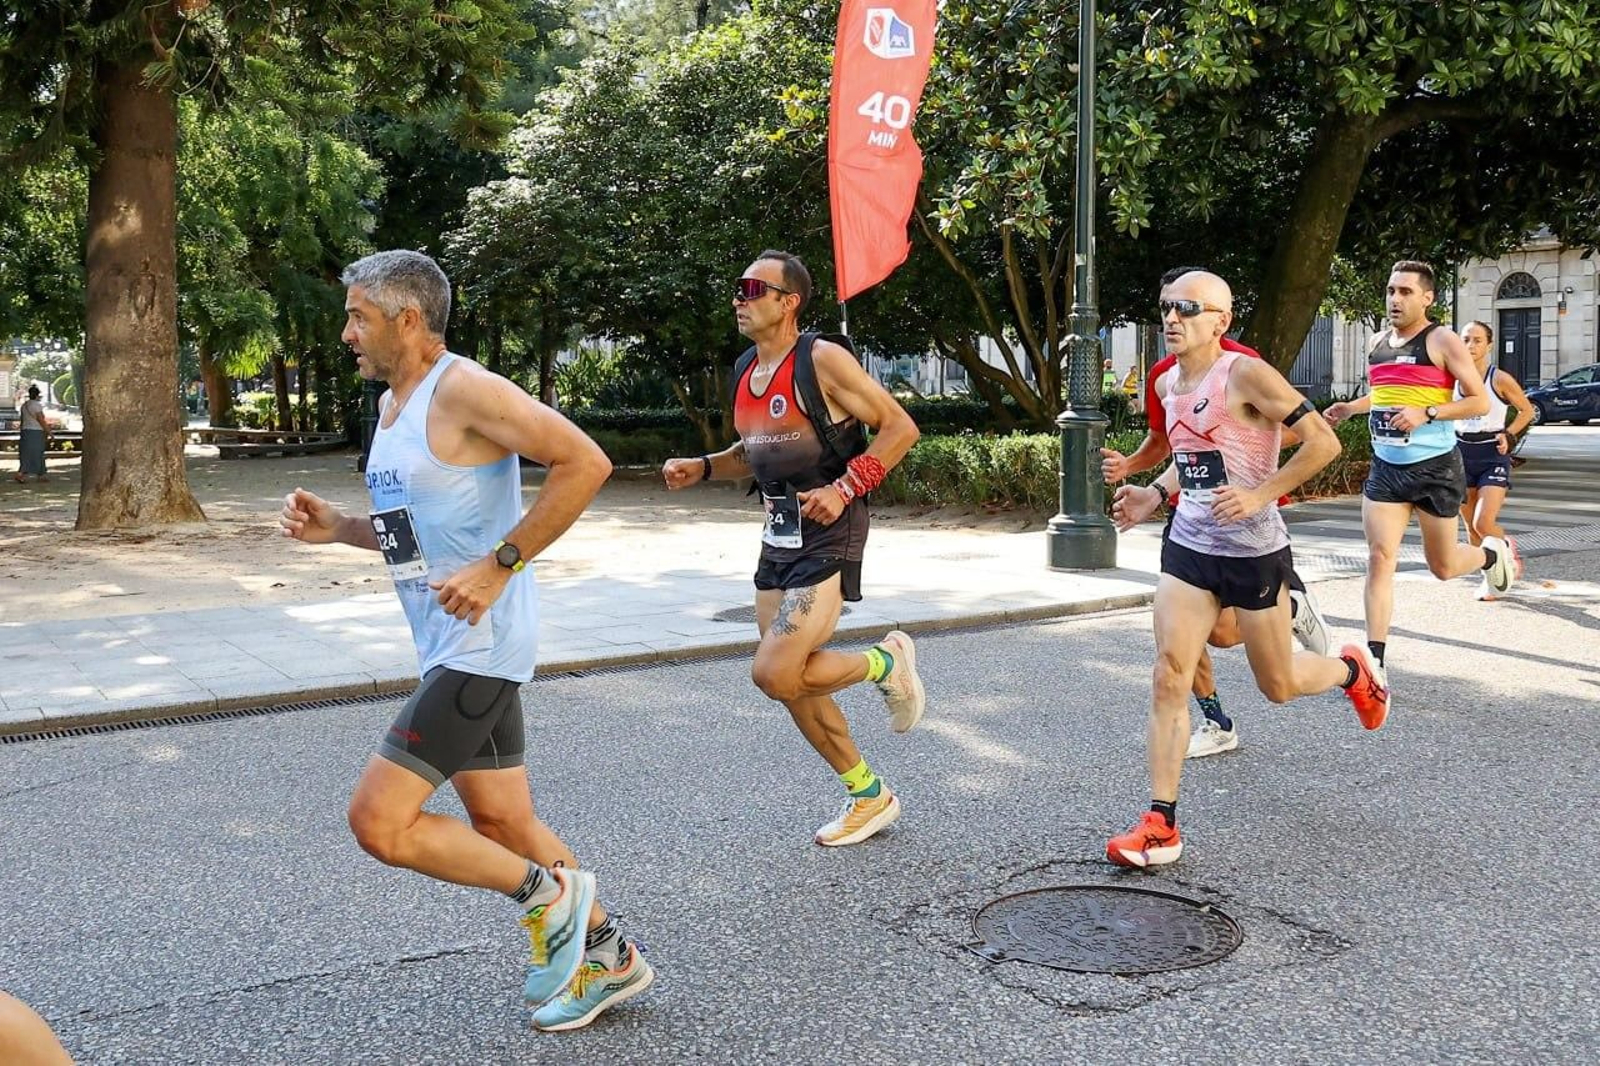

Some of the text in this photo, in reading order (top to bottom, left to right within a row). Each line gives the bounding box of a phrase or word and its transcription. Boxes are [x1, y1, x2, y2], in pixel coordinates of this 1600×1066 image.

[858, 91, 911, 129] 40
[867, 130, 898, 150] MIN
[1184, 465, 1210, 479] 422
